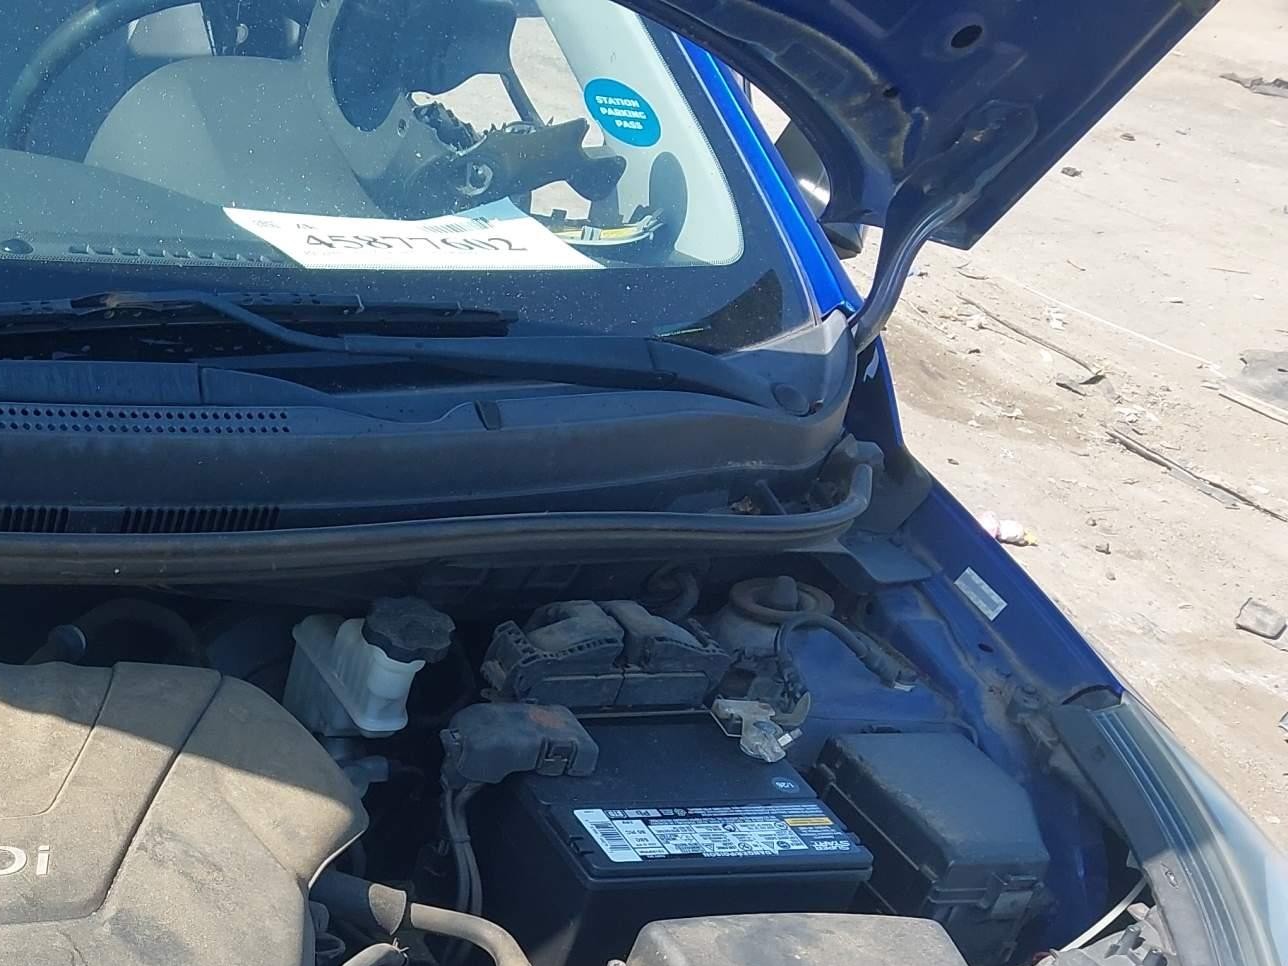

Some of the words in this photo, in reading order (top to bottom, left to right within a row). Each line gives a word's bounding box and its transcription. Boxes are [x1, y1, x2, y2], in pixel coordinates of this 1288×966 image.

[595, 95, 640, 108] STATION
[599, 106, 647, 119] PARKING
[614, 119, 644, 130] PASS
[306, 233, 529, 252] 45877602
